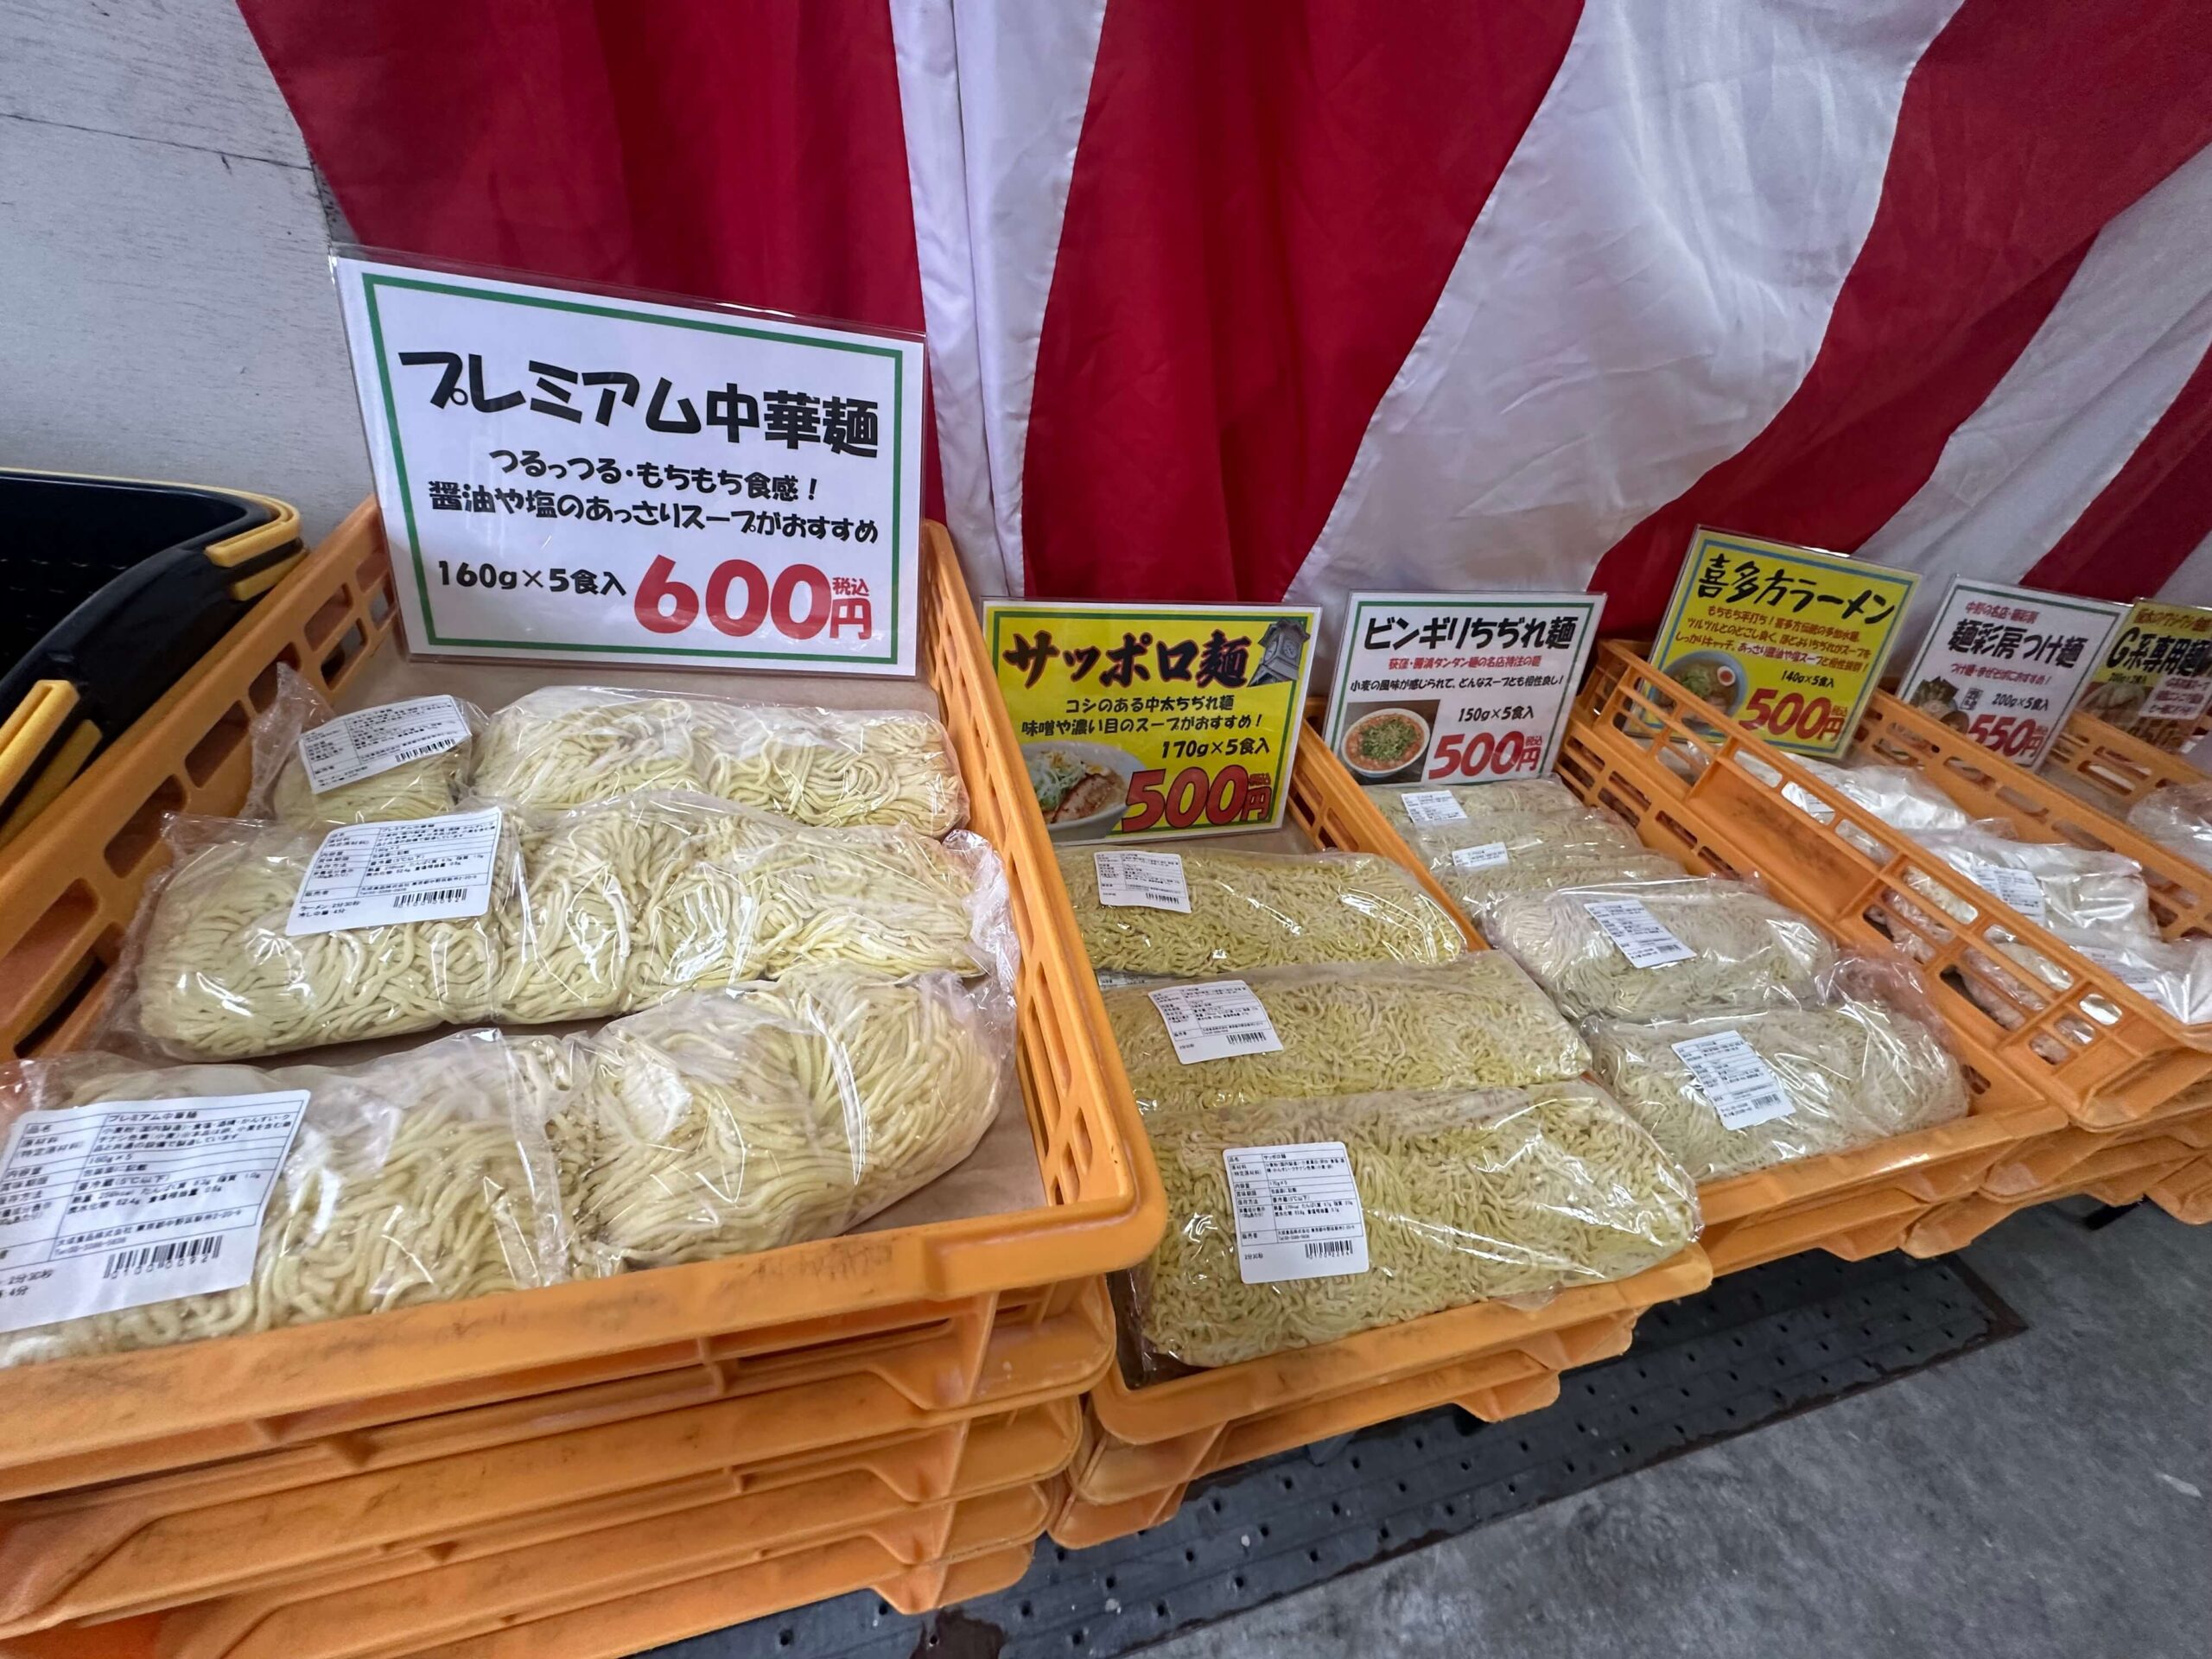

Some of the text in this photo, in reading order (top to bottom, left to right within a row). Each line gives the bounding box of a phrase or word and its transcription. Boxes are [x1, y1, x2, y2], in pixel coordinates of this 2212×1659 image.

[397, 351, 879, 458] プレミアム中華麺
[429, 480, 878, 543] 醤油や塩のあっさりスープがおすすめ
[438, 559, 627, 598] 160g×5食入
[1698, 553, 1895, 625] 喜多方ラーメン
[1364, 616, 1578, 651] ビンギリちぢれ麺
[1002, 629, 1252, 690] サッポロ麺
[1065, 695, 1235, 715] コシのある中太ちぢれ麺
[1459, 706, 1535, 722] 150g×5食入
[1161, 737, 1271, 760] 170g×5食入
